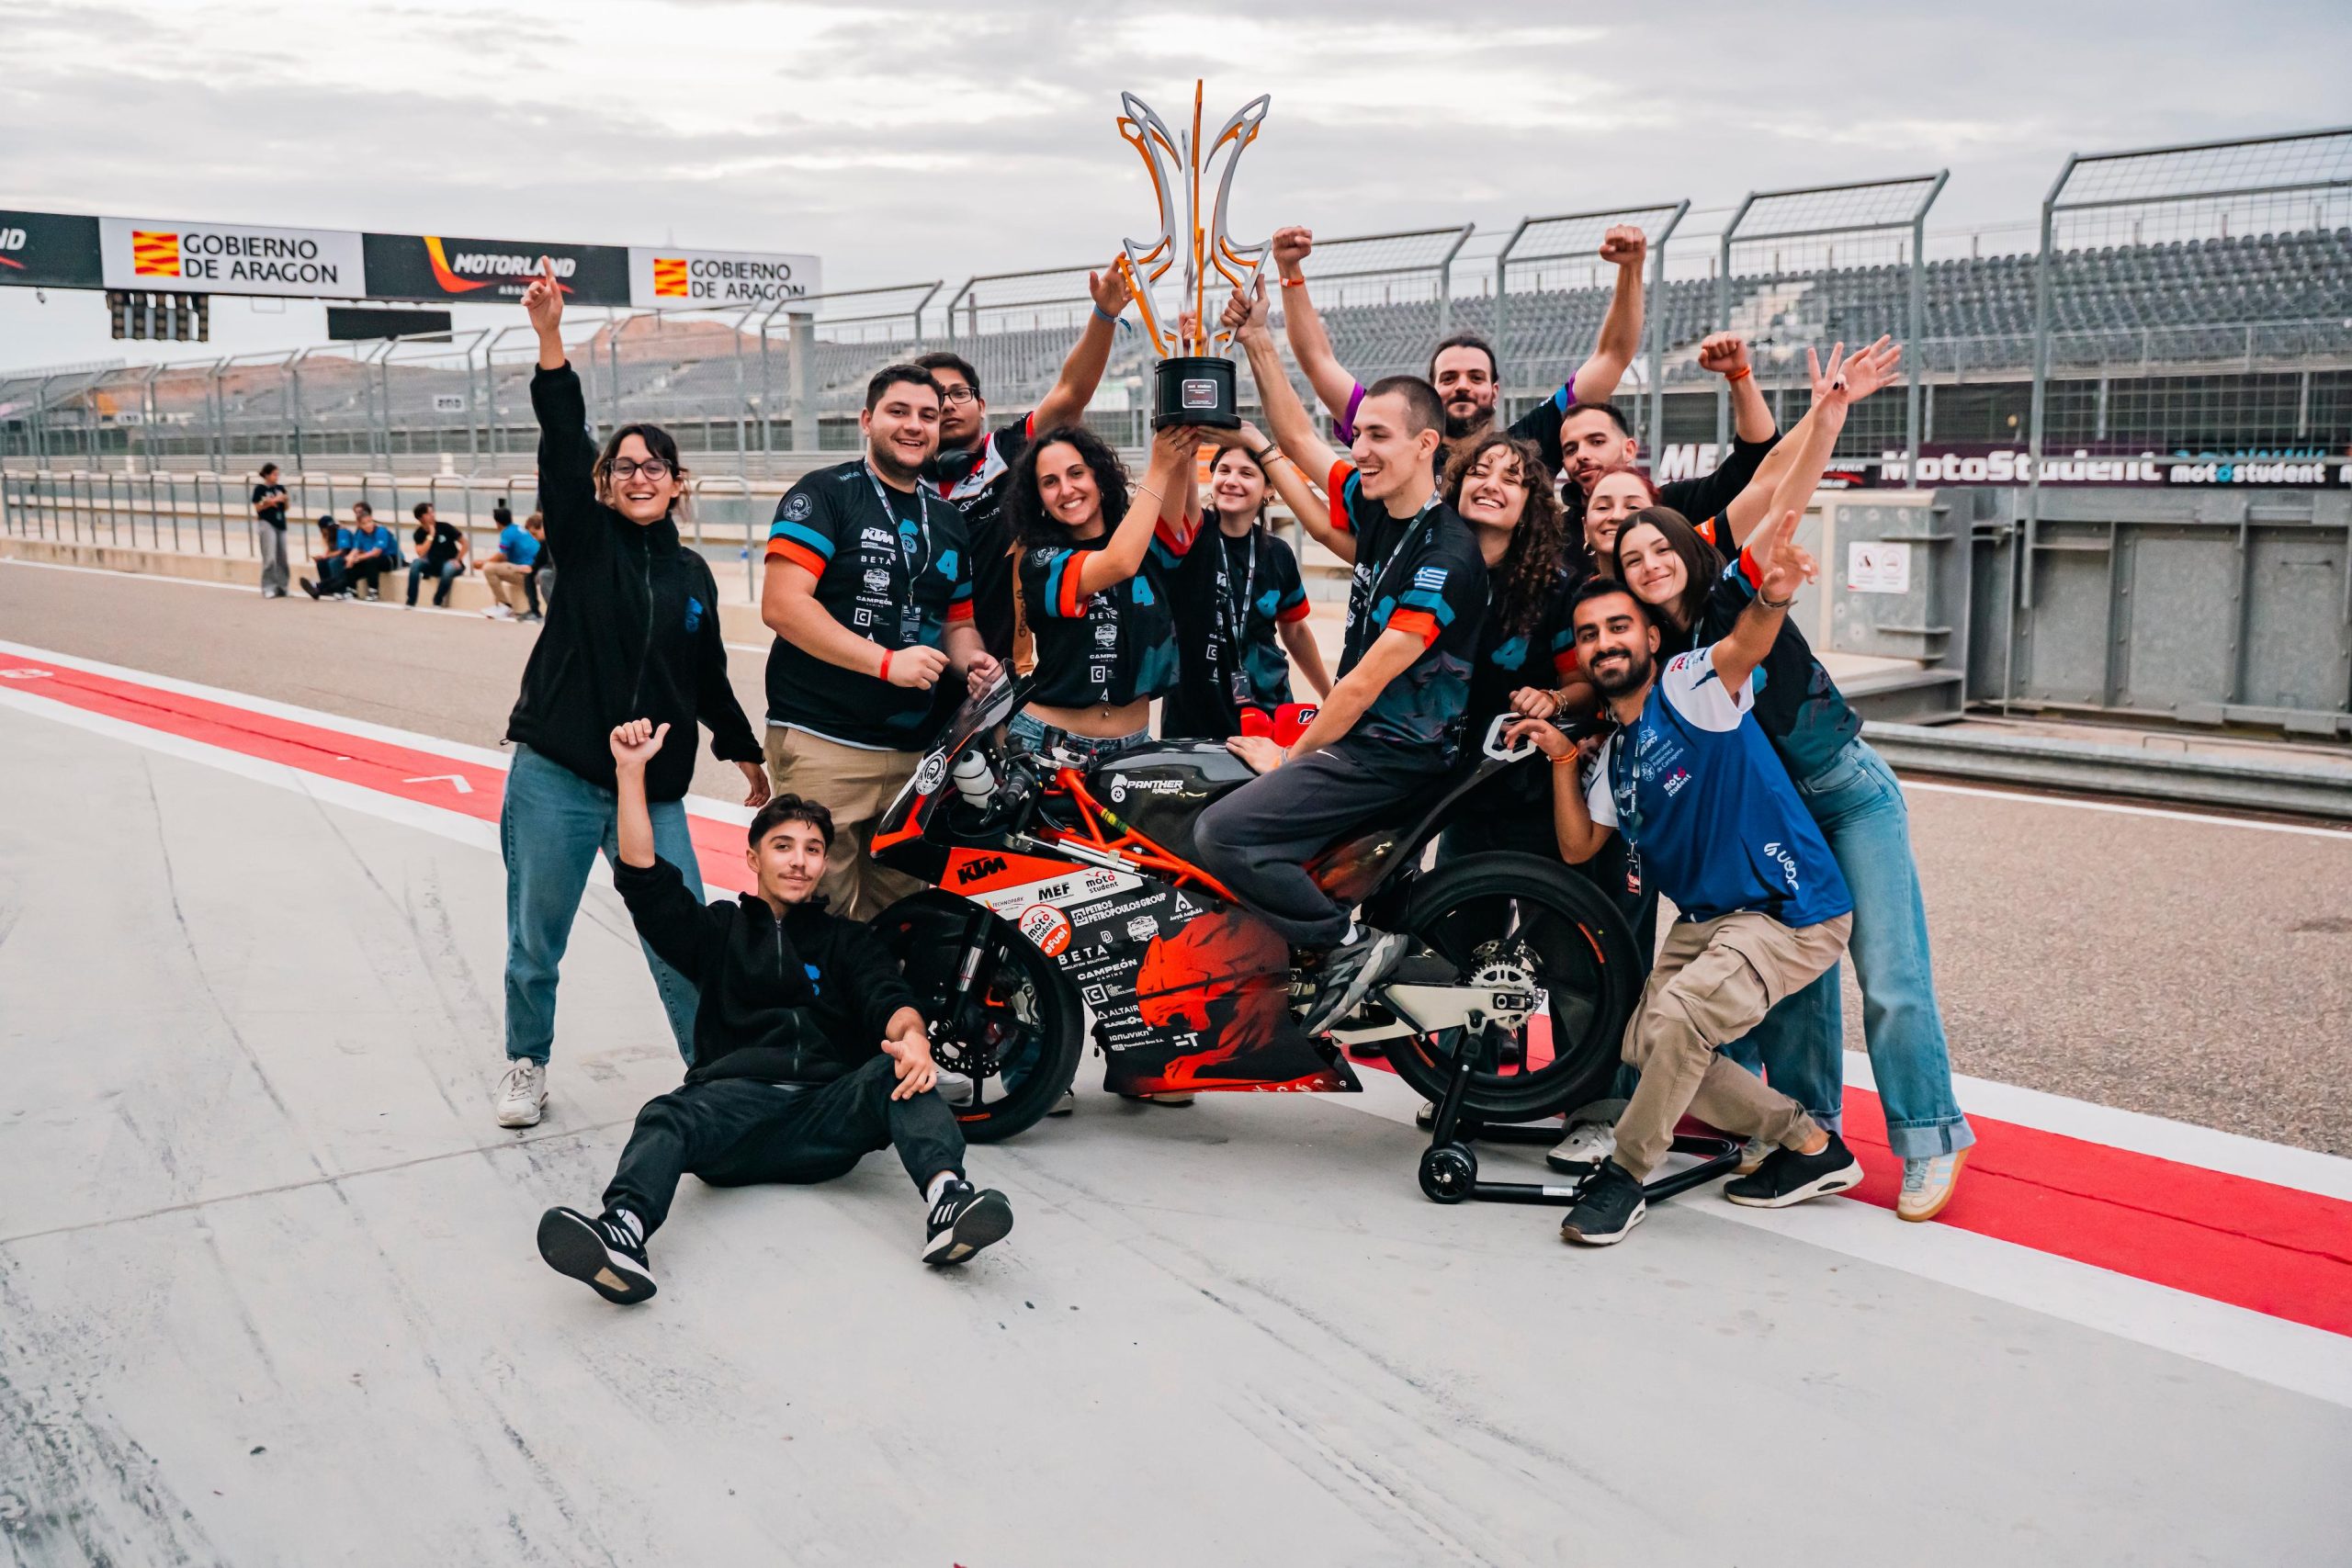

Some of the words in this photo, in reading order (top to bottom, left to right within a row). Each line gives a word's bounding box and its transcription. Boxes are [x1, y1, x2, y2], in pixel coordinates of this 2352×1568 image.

[184, 233, 317, 260] GOBIERNO
[186, 258, 220, 279] DE
[231, 260, 338, 284] ARAGON
[691, 260, 791, 281] GOBIERNO
[692, 281, 717, 299] DE
[725, 283, 805, 300] ARAGON
[1659, 444, 1735, 479] ME
[1881, 449, 2162, 481] MotoStudent
[2170, 462, 2325, 483] motostudent
[860, 527, 895, 545] KTM
[861, 555, 891, 566] BETA
[936, 549, 957, 581] 4
[855, 595, 892, 606] CAMPEÓN
[1132, 575, 1155, 606] 4
[1126, 780, 1183, 790] PANTHER
[1668, 773, 1692, 797] student
[957, 856, 1007, 885] KTM
[1086, 874, 1115, 888] moto
[1038, 882, 1070, 901] MEF
[1089, 881, 1119, 894] student
[992, 896, 1024, 908] TECHNOPARK
[1084, 899, 1114, 915] PETROS
[1028, 913, 1050, 939] moto
[1034, 919, 1057, 944] student
[1044, 926, 1069, 954] eFuel
[1057, 944, 1108, 965] BETA
[1087, 955, 1111, 964] SOLUTIONS
[1077, 958, 1138, 981] CAMPEÓN
[1096, 971, 1124, 982] GAMING
[1109, 1004, 1140, 1017] ALTAIR
